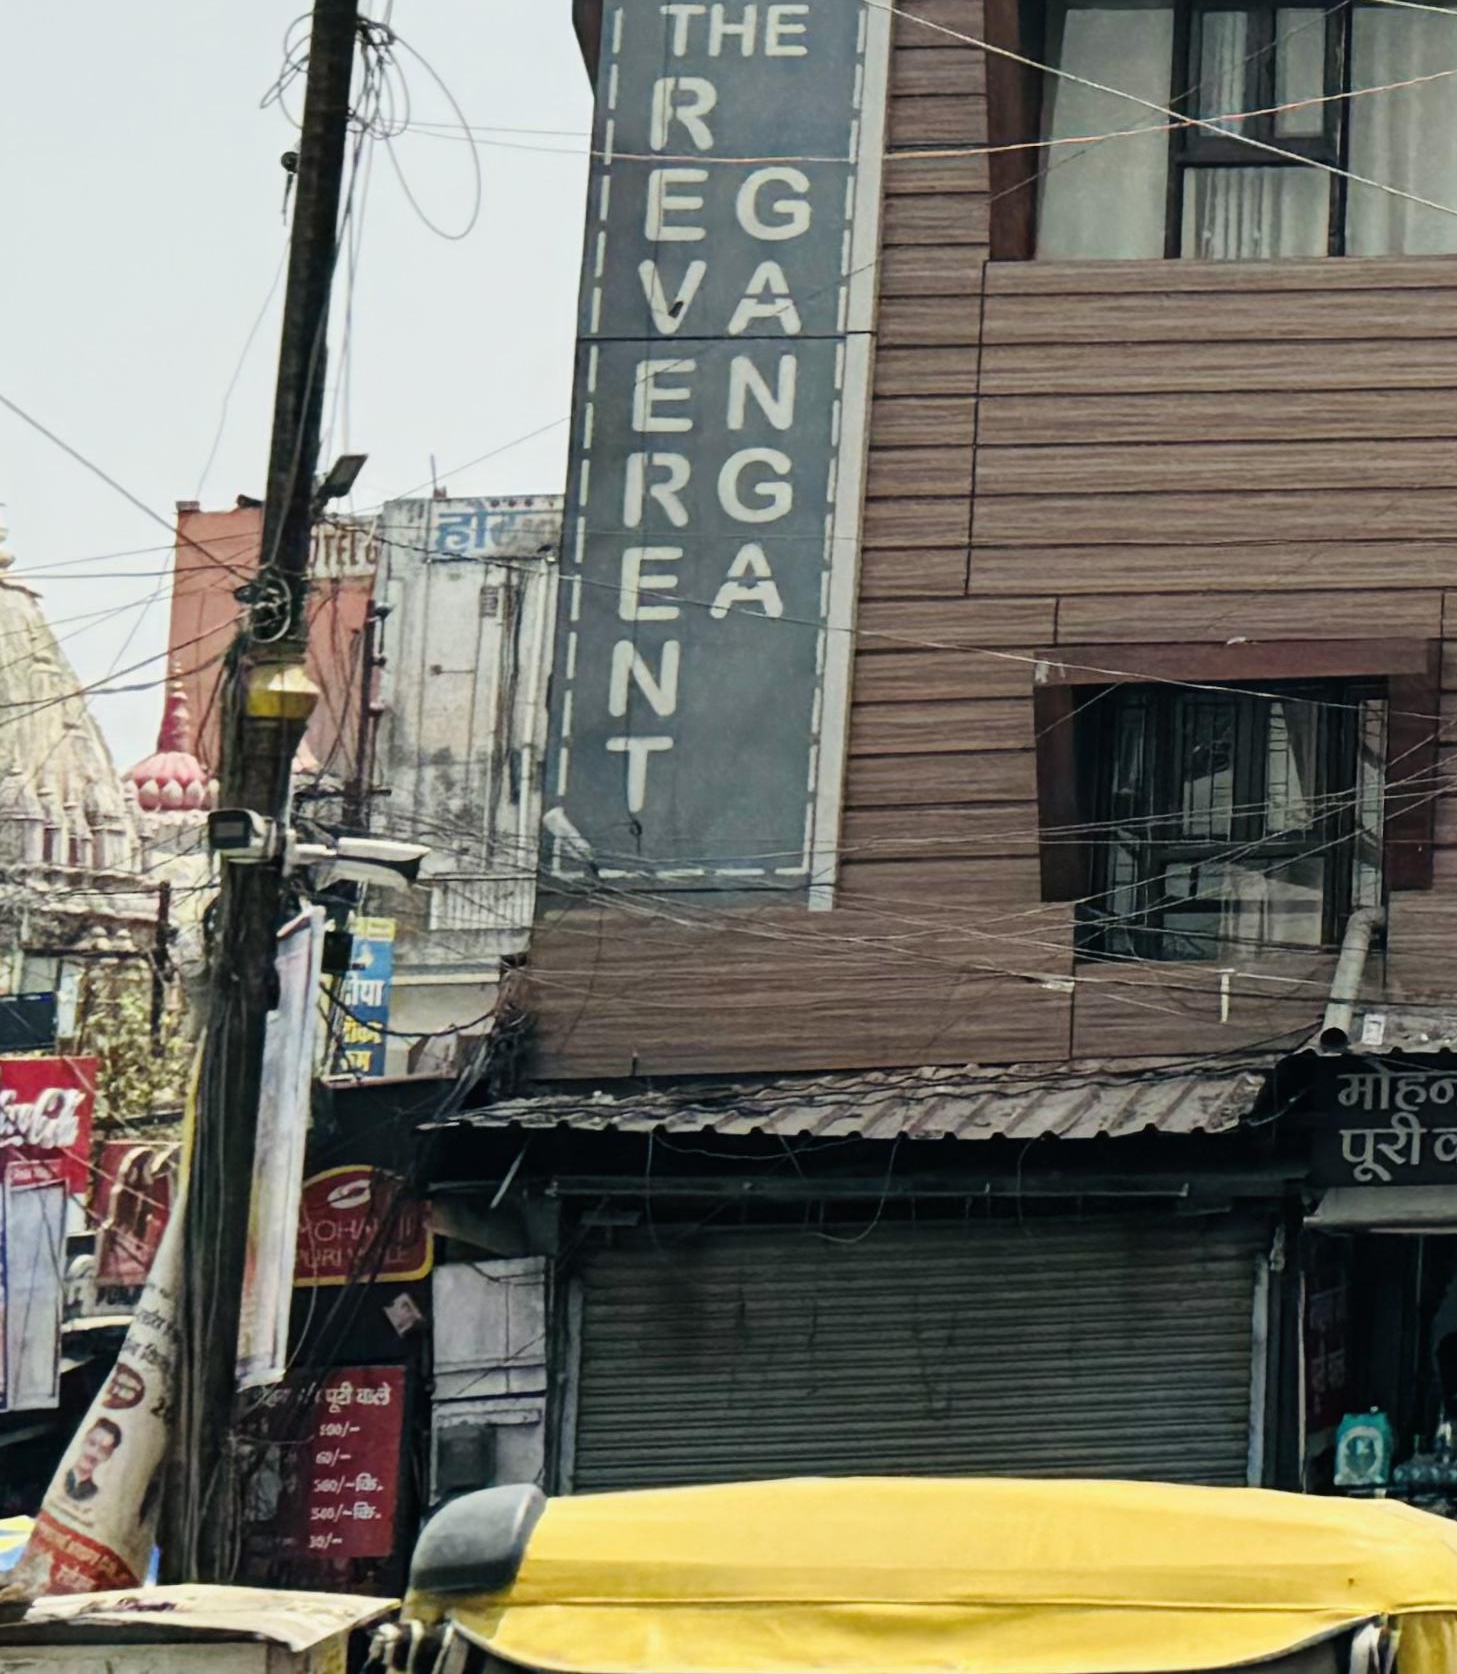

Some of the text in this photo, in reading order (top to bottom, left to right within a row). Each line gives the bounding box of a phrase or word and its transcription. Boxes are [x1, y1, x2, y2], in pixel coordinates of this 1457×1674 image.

[660, 3, 809, 57] THE
[605, 76, 717, 814] REVERENT
[709, 166, 811, 620] GANGA
[1339, 1112, 1427, 1182] पूरी
